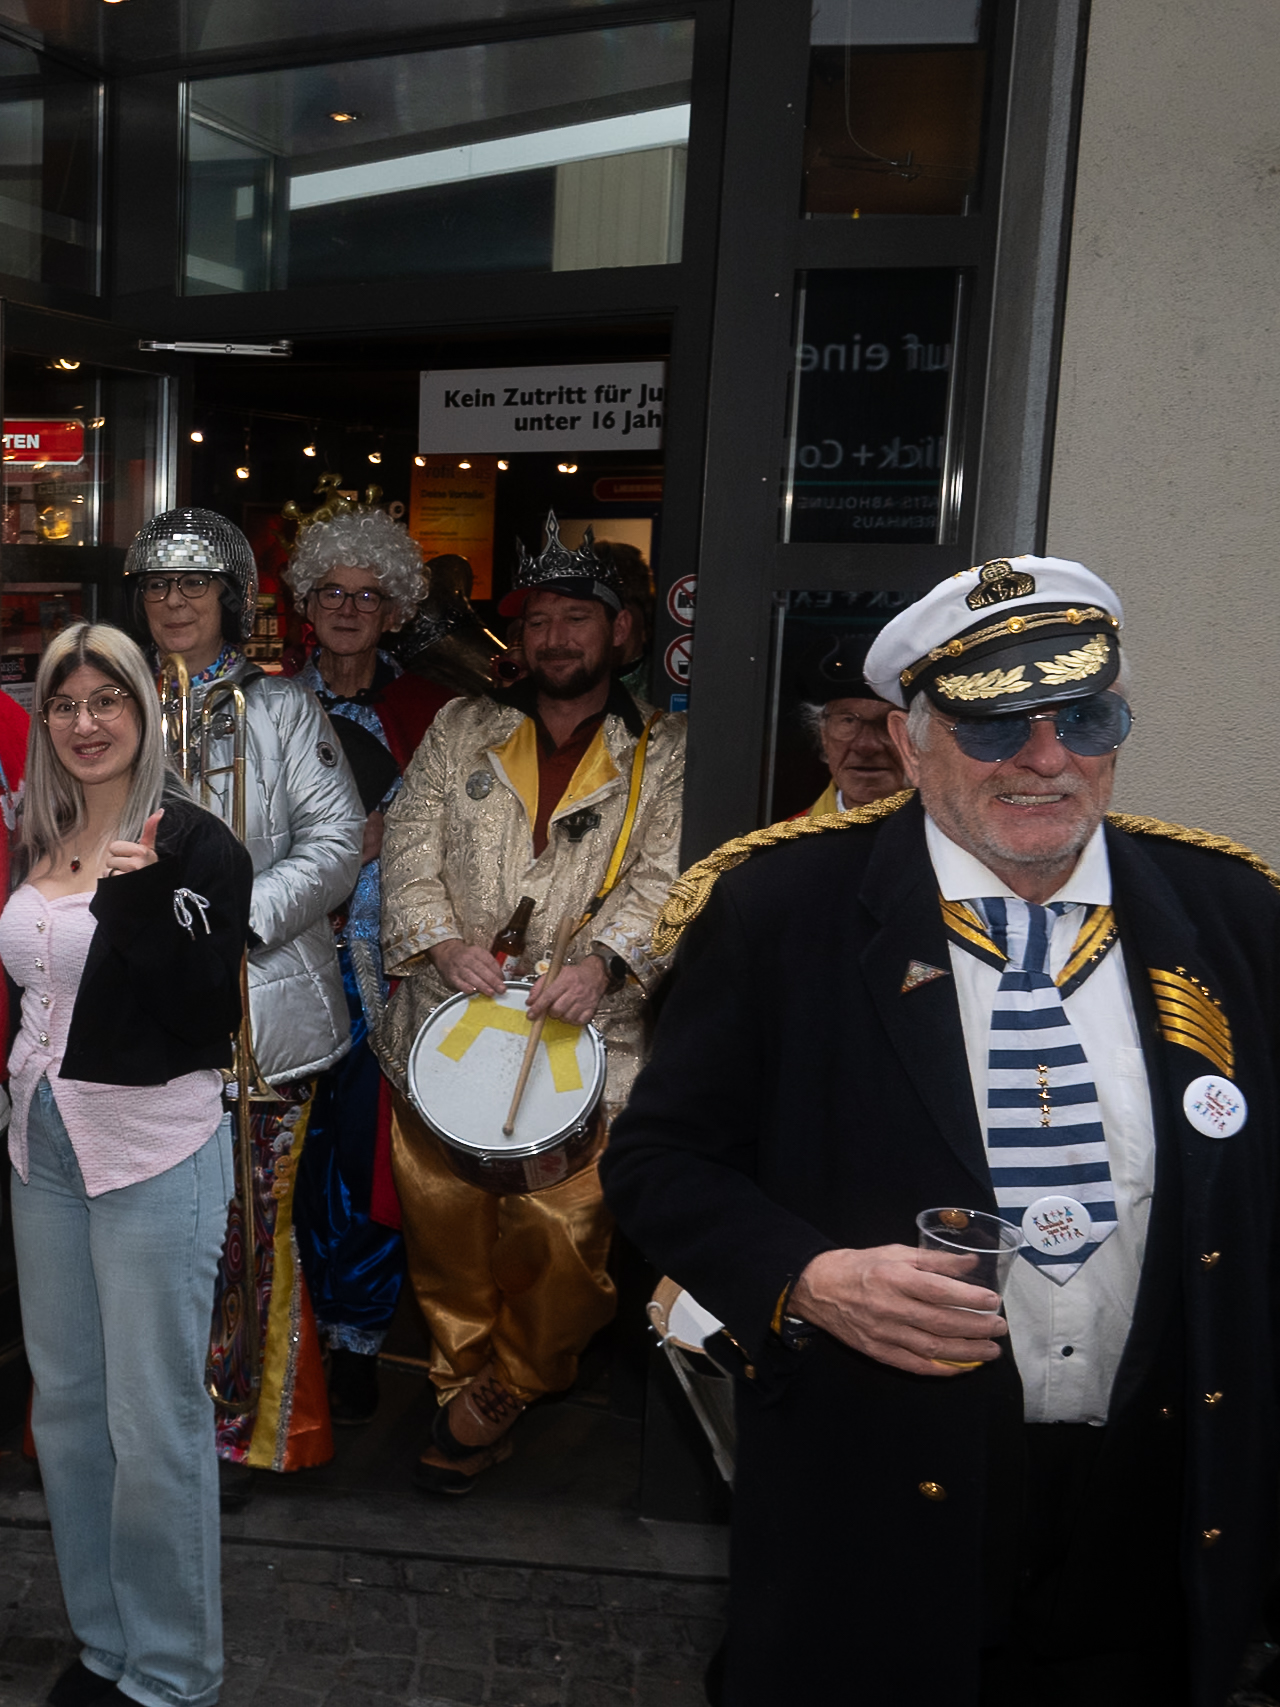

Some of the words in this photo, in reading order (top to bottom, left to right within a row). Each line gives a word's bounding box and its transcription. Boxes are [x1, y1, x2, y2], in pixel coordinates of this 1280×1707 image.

[445, 389, 496, 408] Kein
[503, 386, 587, 406] Zutritt
[595, 384, 632, 403] für
[514, 413, 581, 432] unter
[593, 411, 616, 430] 16
